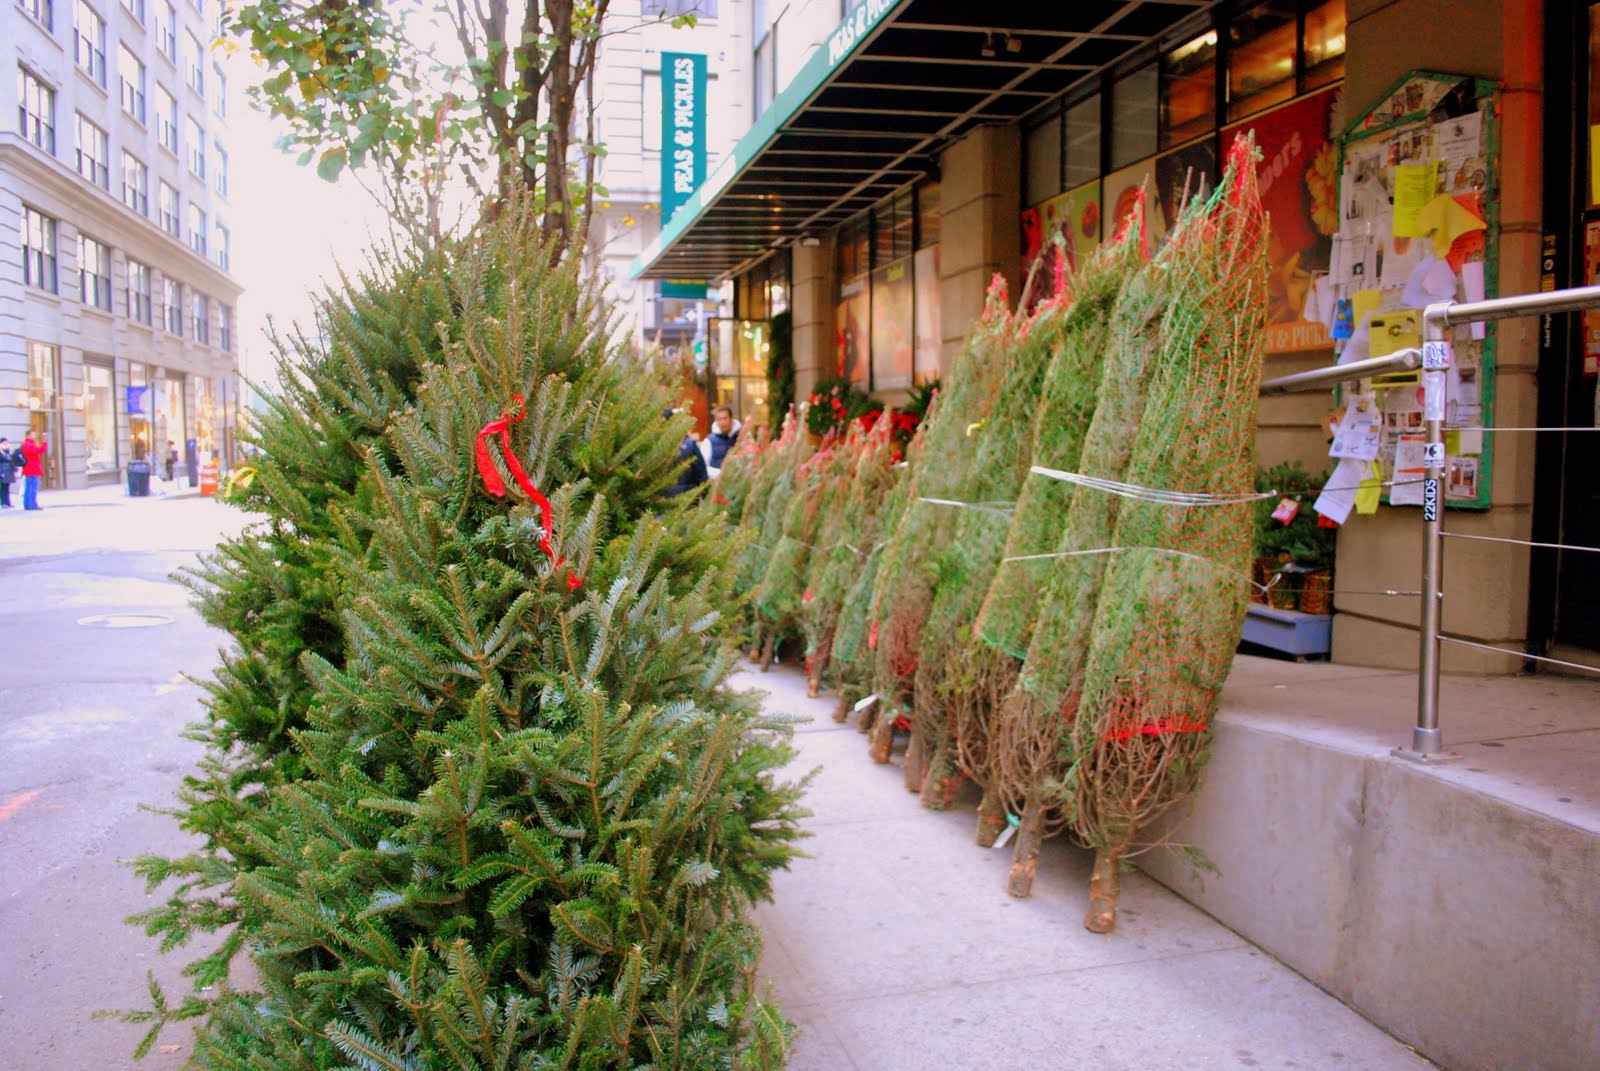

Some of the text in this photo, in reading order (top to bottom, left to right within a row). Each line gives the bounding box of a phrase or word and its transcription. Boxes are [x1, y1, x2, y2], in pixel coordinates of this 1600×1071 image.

[829, 16, 855, 66] PEAS
[674, 58, 694, 128] PICKLES
[674, 129, 694, 147] &
[674, 149, 694, 193] PEAS
[1424, 479, 1437, 521] 22KIDS
